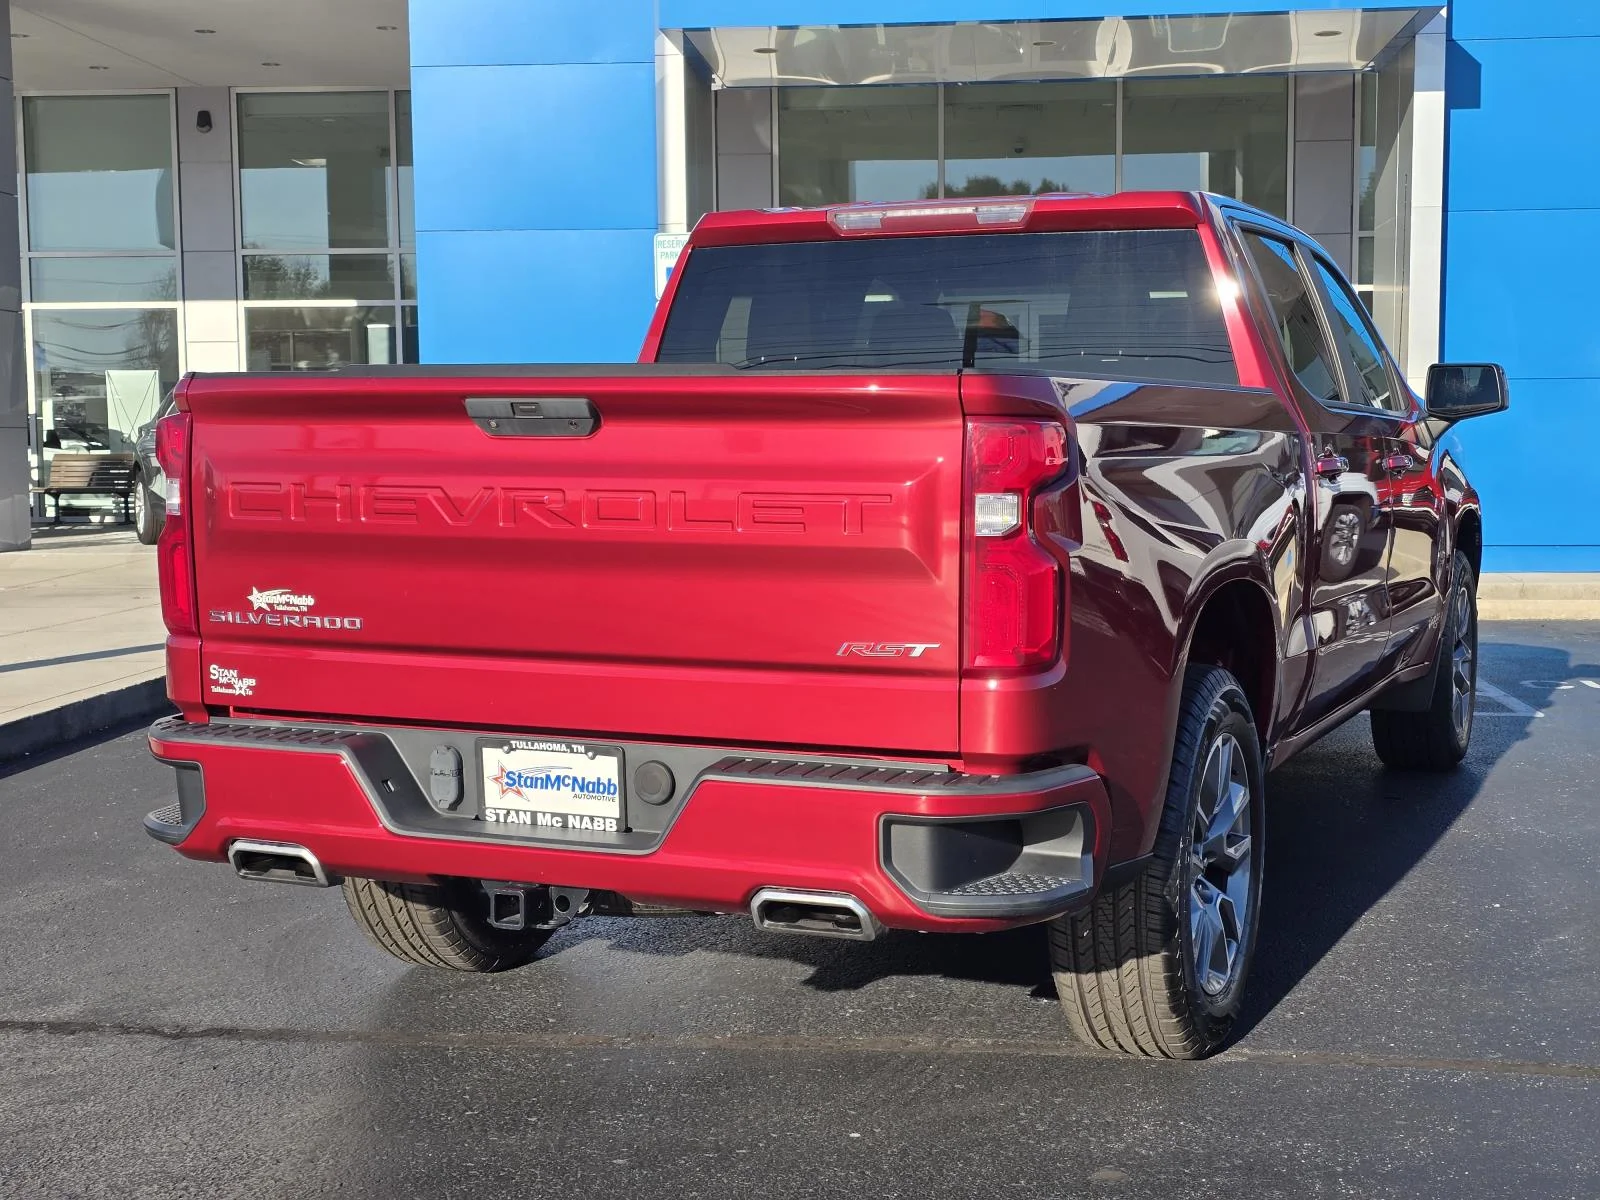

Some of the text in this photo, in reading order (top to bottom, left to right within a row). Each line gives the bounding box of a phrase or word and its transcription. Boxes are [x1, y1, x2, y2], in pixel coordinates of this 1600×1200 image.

[657, 240, 687, 249] RESERV
[660, 252, 678, 260] PARK
[227, 480, 895, 536] CHEVROLET
[209, 610, 364, 630] SILVERADO
[836, 641, 941, 657] RST
[510, 740, 585, 753] TULLAHOMA, TN
[504, 770, 618, 796] StanMcNabb
[573, 793, 617, 802] AUTOMOTIVE
[485, 808, 618, 832] STAN Mc NABB
